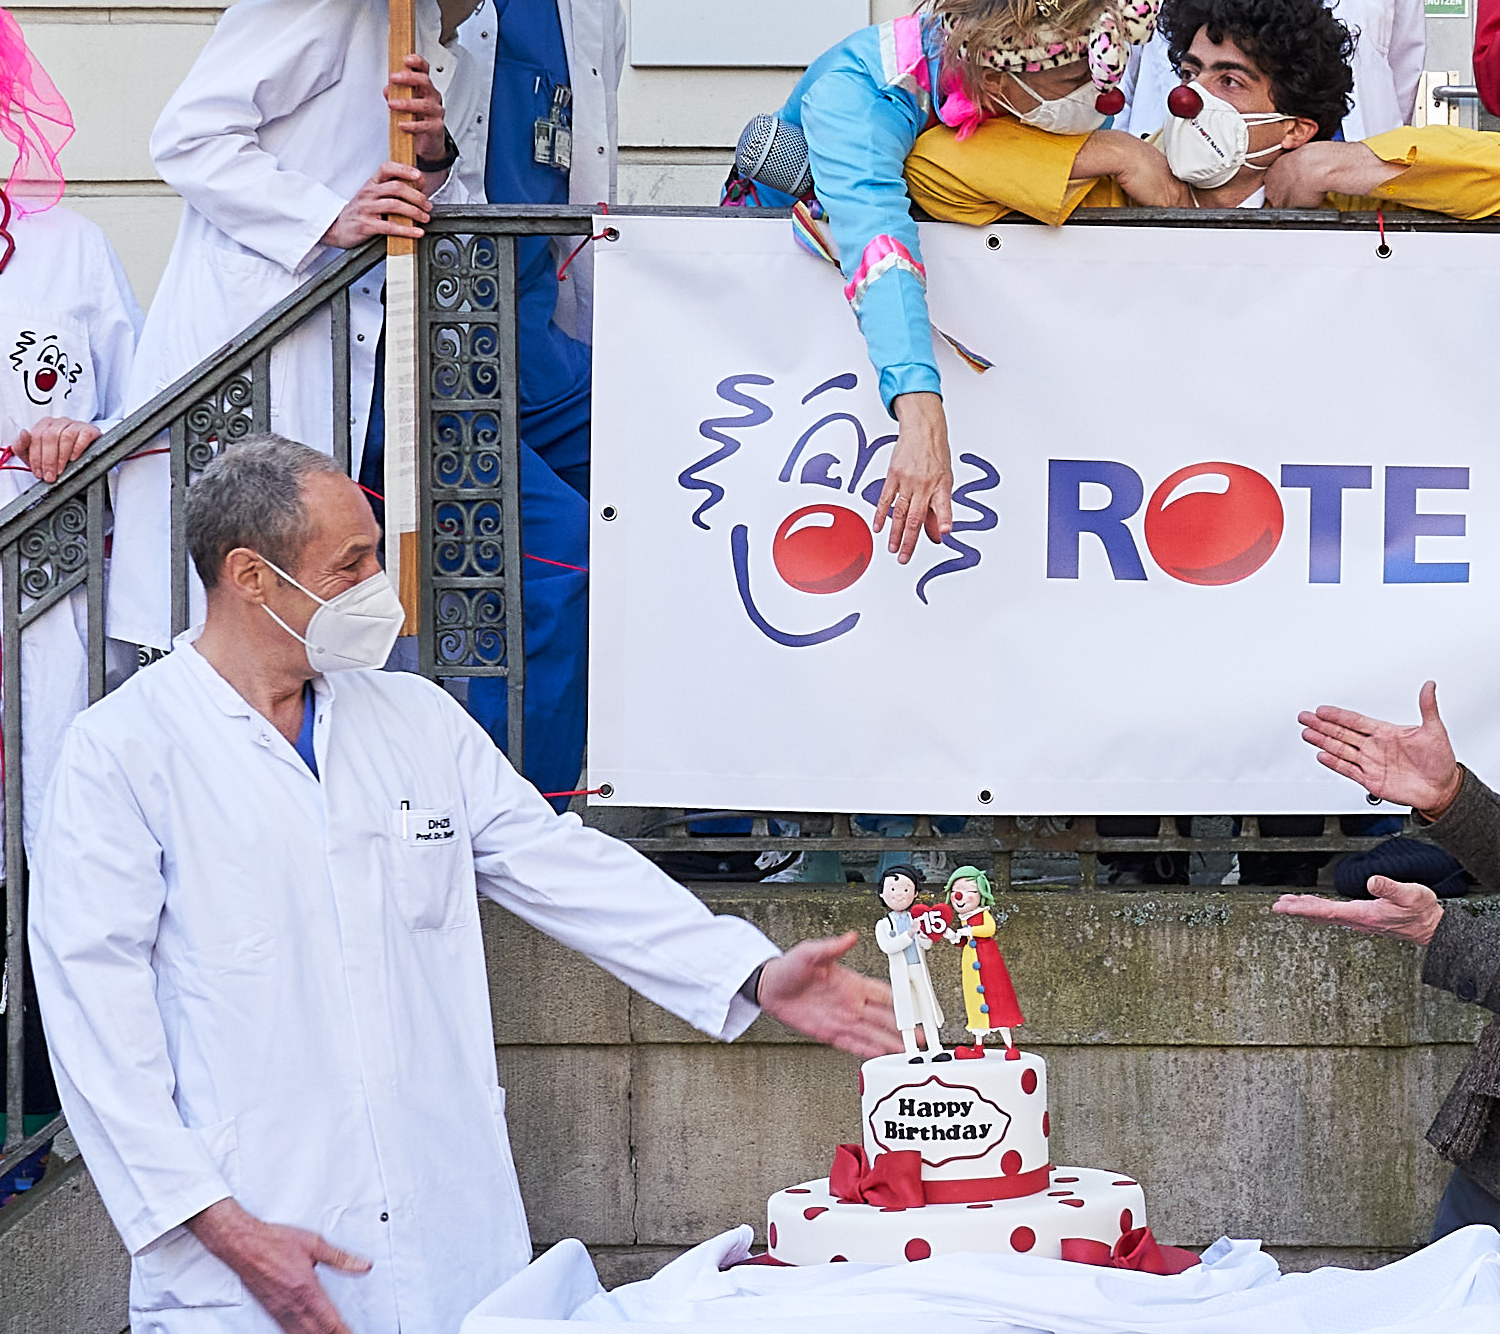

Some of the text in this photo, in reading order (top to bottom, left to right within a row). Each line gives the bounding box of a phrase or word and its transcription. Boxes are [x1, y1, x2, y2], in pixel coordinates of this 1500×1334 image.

[1046, 458, 1470, 586] ROTE
[922, 910, 947, 934] 15
[898, 1097, 974, 1120] Happy
[884, 1120, 993, 1141] Birthday
